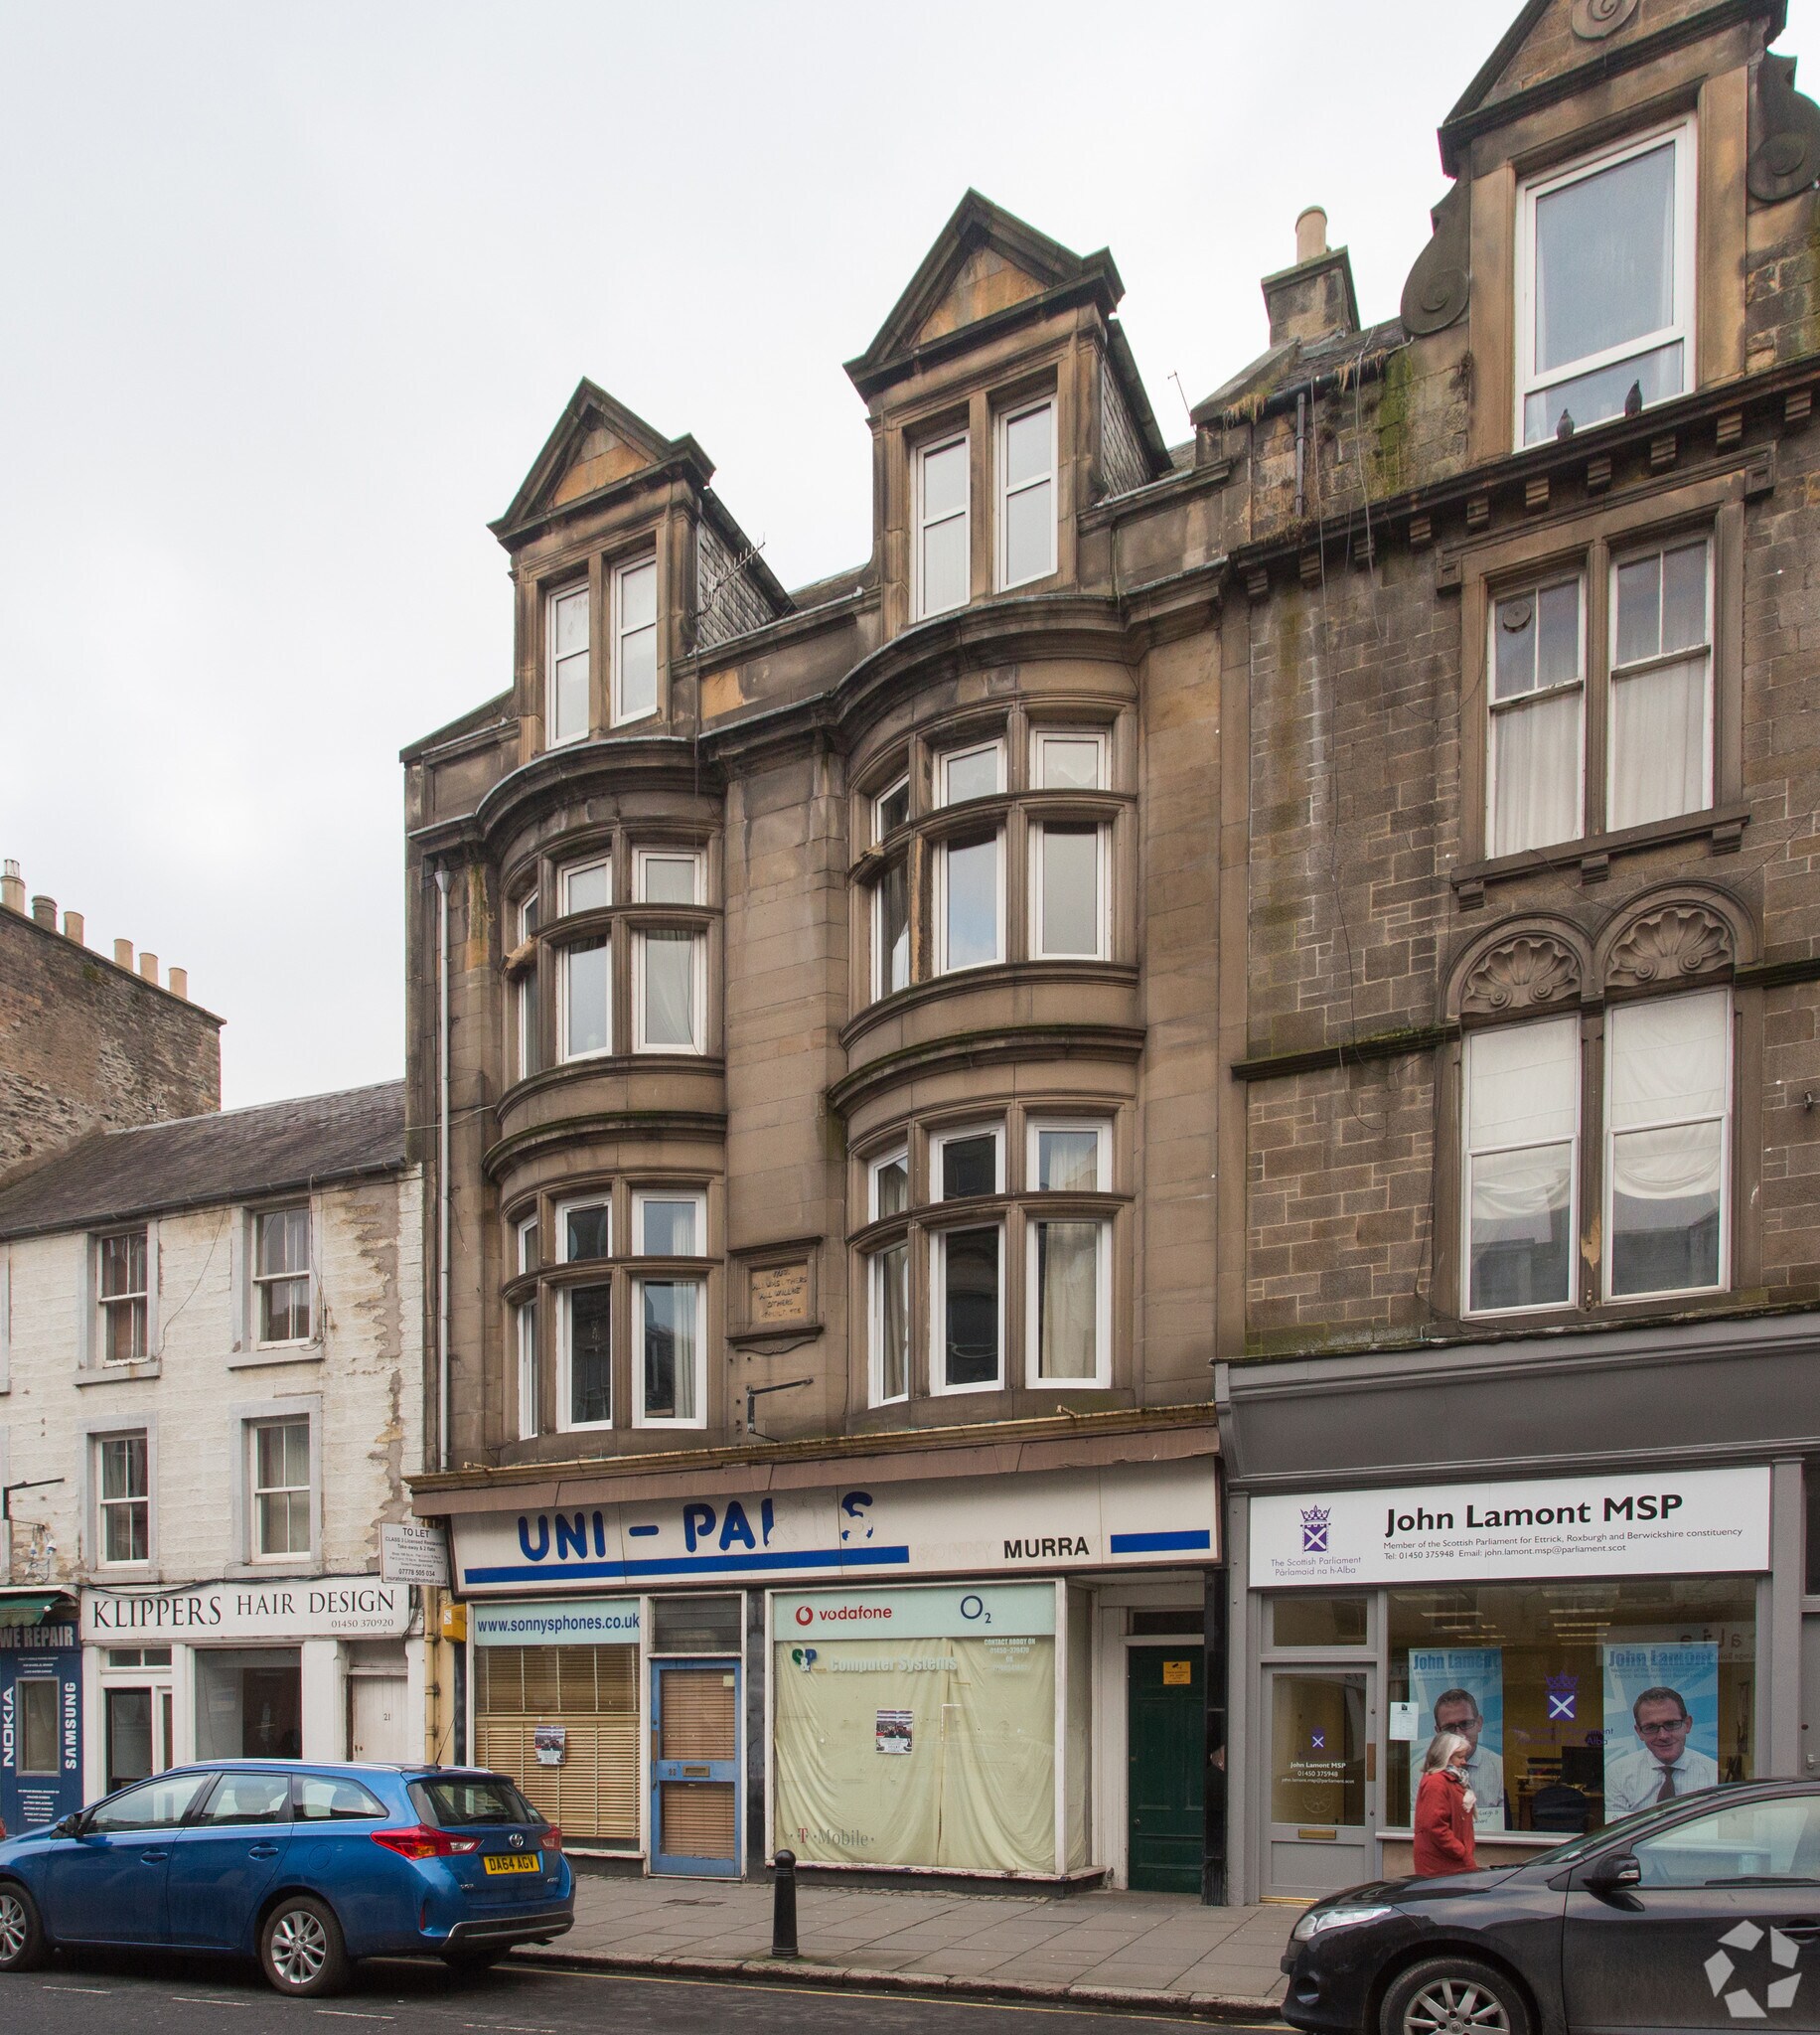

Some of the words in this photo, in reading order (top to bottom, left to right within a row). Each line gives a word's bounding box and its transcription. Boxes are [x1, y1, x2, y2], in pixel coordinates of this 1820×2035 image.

[1385, 1507, 1454, 1538] John
[1466, 1502, 1592, 1528] Lamont
[1603, 1493, 1683, 1522] MSP
[402, 1527, 413, 1536] TO
[415, 1529, 430, 1538] LET
[517, 1509, 606, 1562] UNI
[1384, 1541, 1416, 1550] Member
[1442, 1538, 1473, 1547] Scottish
[1475, 1536, 1518, 1546] Parliament
[1534, 1534, 1564, 1544] Ettrick,
[1567, 1533, 1607, 1543] Roxburgh
[1608, 1531, 1625, 1540] and
[1627, 1529, 1684, 1539] Berwickshire
[1686, 1528, 1743, 1537] constituency
[1287, 1557, 1316, 1566] Scottish
[1318, 1556, 1361, 1565] Parliament
[1425, 1550, 1454, 1559] 375948
[1484, 1544, 1626, 1558] john.lamont.msp@parliament.scot
[92, 1596, 222, 1629] KLIPPERS
[236, 1593, 296, 1616] HAIR
[308, 1590, 394, 1614] DESIGN
[820, 1605, 892, 1621] vodafone
[331, 1619, 359, 1629] 01450
[361, 1619, 393, 1628] 370920
[478, 1613, 640, 1635] www.sonnysphones.co.uk
[23, 1626, 74, 1647] REPAIR
[830, 1657, 894, 1673] Computer
[898, 1655, 958, 1672] Systems
[3, 1686, 14, 1767] NOKIA
[65, 1682, 76, 1769] SAMSUNG
[490, 1856, 515, 1871] DA64
[517, 1854, 534, 1869] AGV
